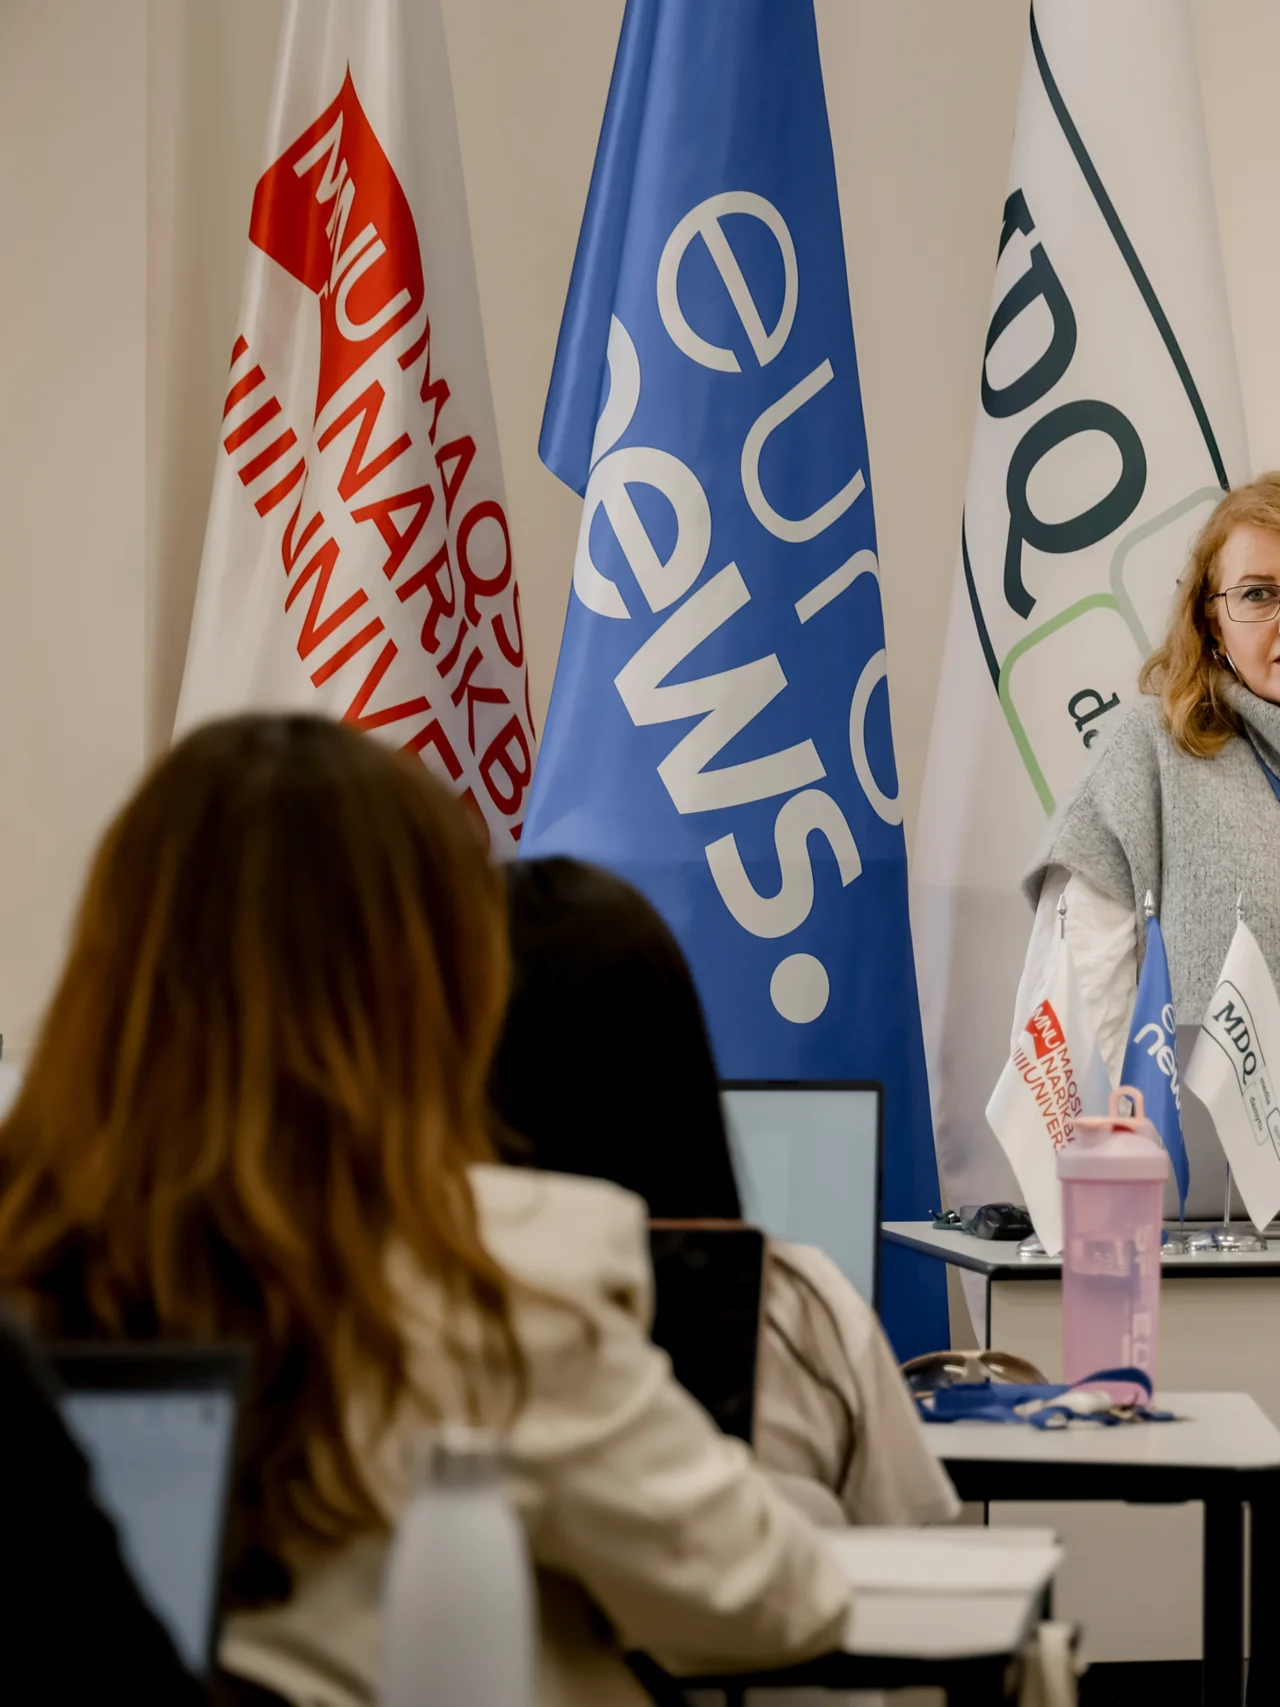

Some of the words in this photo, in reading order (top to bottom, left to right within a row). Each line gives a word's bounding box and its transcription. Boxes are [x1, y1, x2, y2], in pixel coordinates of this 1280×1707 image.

[397, 314, 535, 741] MAQS
[282, 456, 475, 800] UNIV
[317, 380, 531, 840] NARIKB
[1032, 1005, 1061, 1049] MNU
[1133, 1023, 1182, 1122] new
[1212, 1001, 1257, 1085] MDQ
[1023, 1065, 1065, 1150] UNIVER
